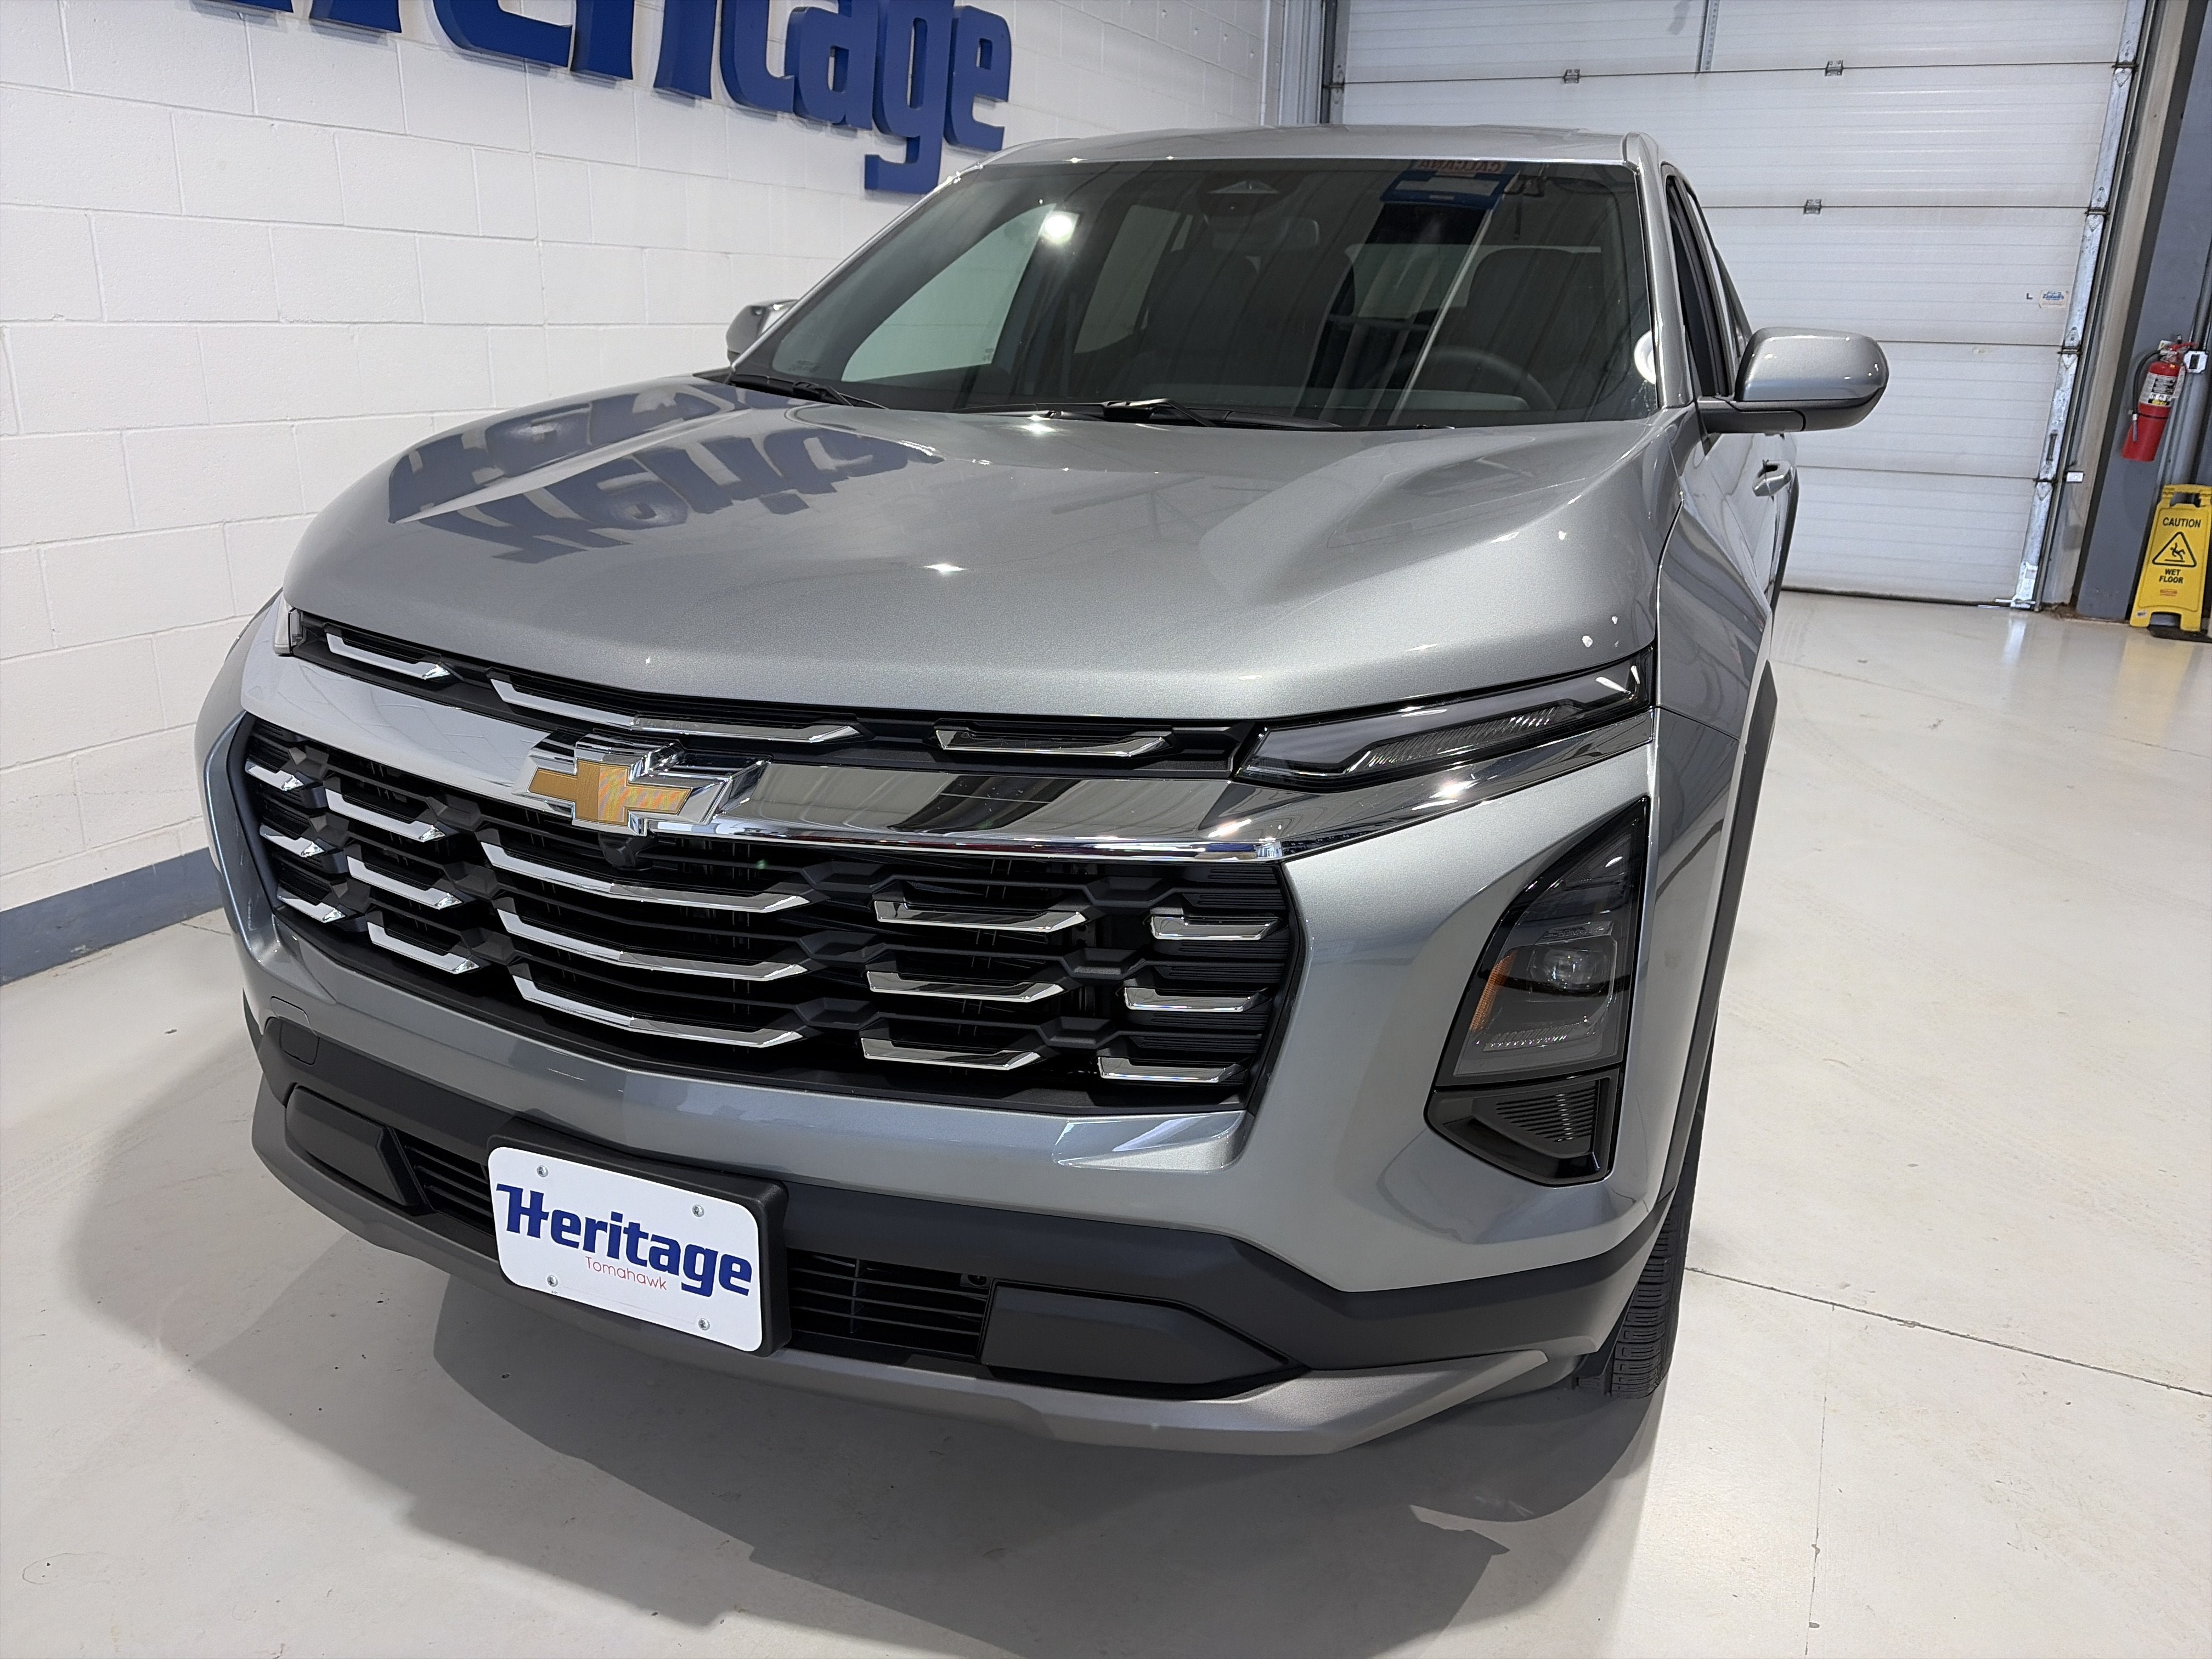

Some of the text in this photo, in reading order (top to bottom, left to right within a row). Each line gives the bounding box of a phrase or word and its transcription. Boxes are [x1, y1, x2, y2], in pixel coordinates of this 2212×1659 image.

[2163, 517, 2201, 527] CAUTION
[496, 1183, 752, 1297] Heritage
[585, 1256, 667, 1290] Tomahawk
